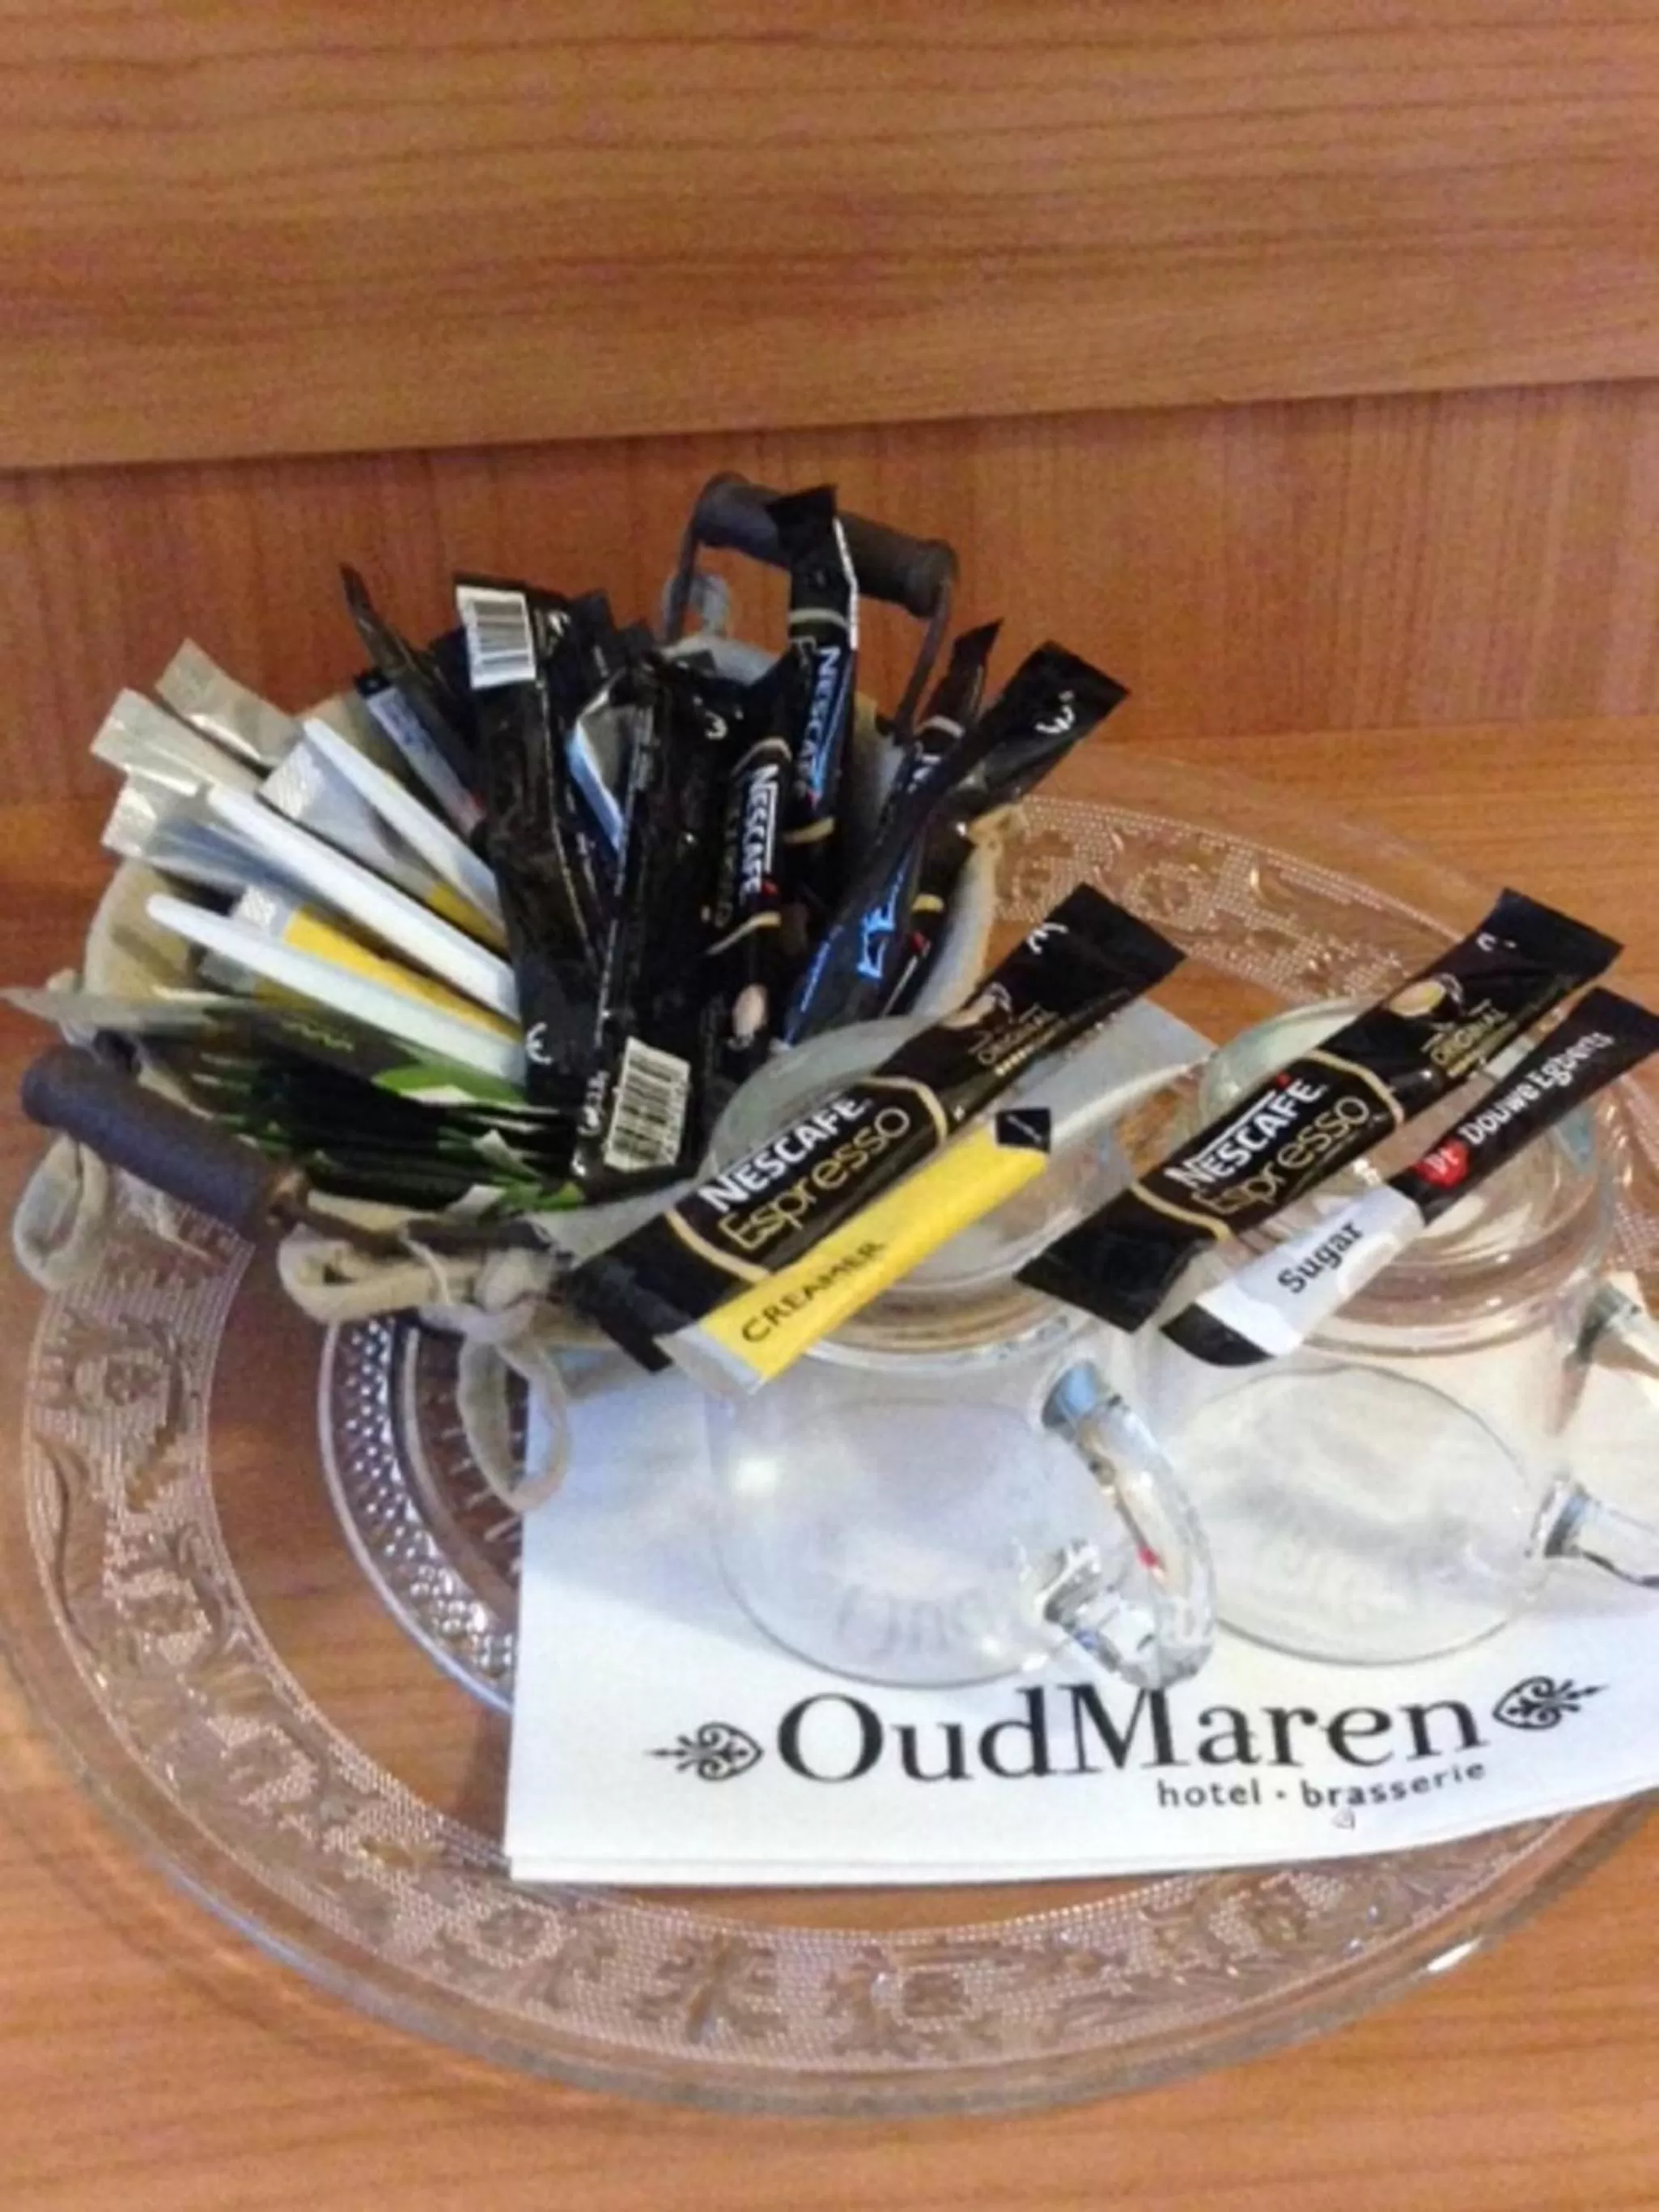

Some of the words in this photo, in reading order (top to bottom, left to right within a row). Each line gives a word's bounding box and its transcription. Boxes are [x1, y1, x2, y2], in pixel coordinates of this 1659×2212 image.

[1457, 1082, 1540, 1146] Douwe
[717, 1106, 910, 1250] Espresso
[741, 1242, 885, 1344] CREAMER
[1276, 1220, 1364, 1294] Sugar
[776, 1683, 1491, 1782] OudMaren
[1157, 1777, 1262, 1808] hotel
[1300, 1762, 1487, 1808] brasserie
